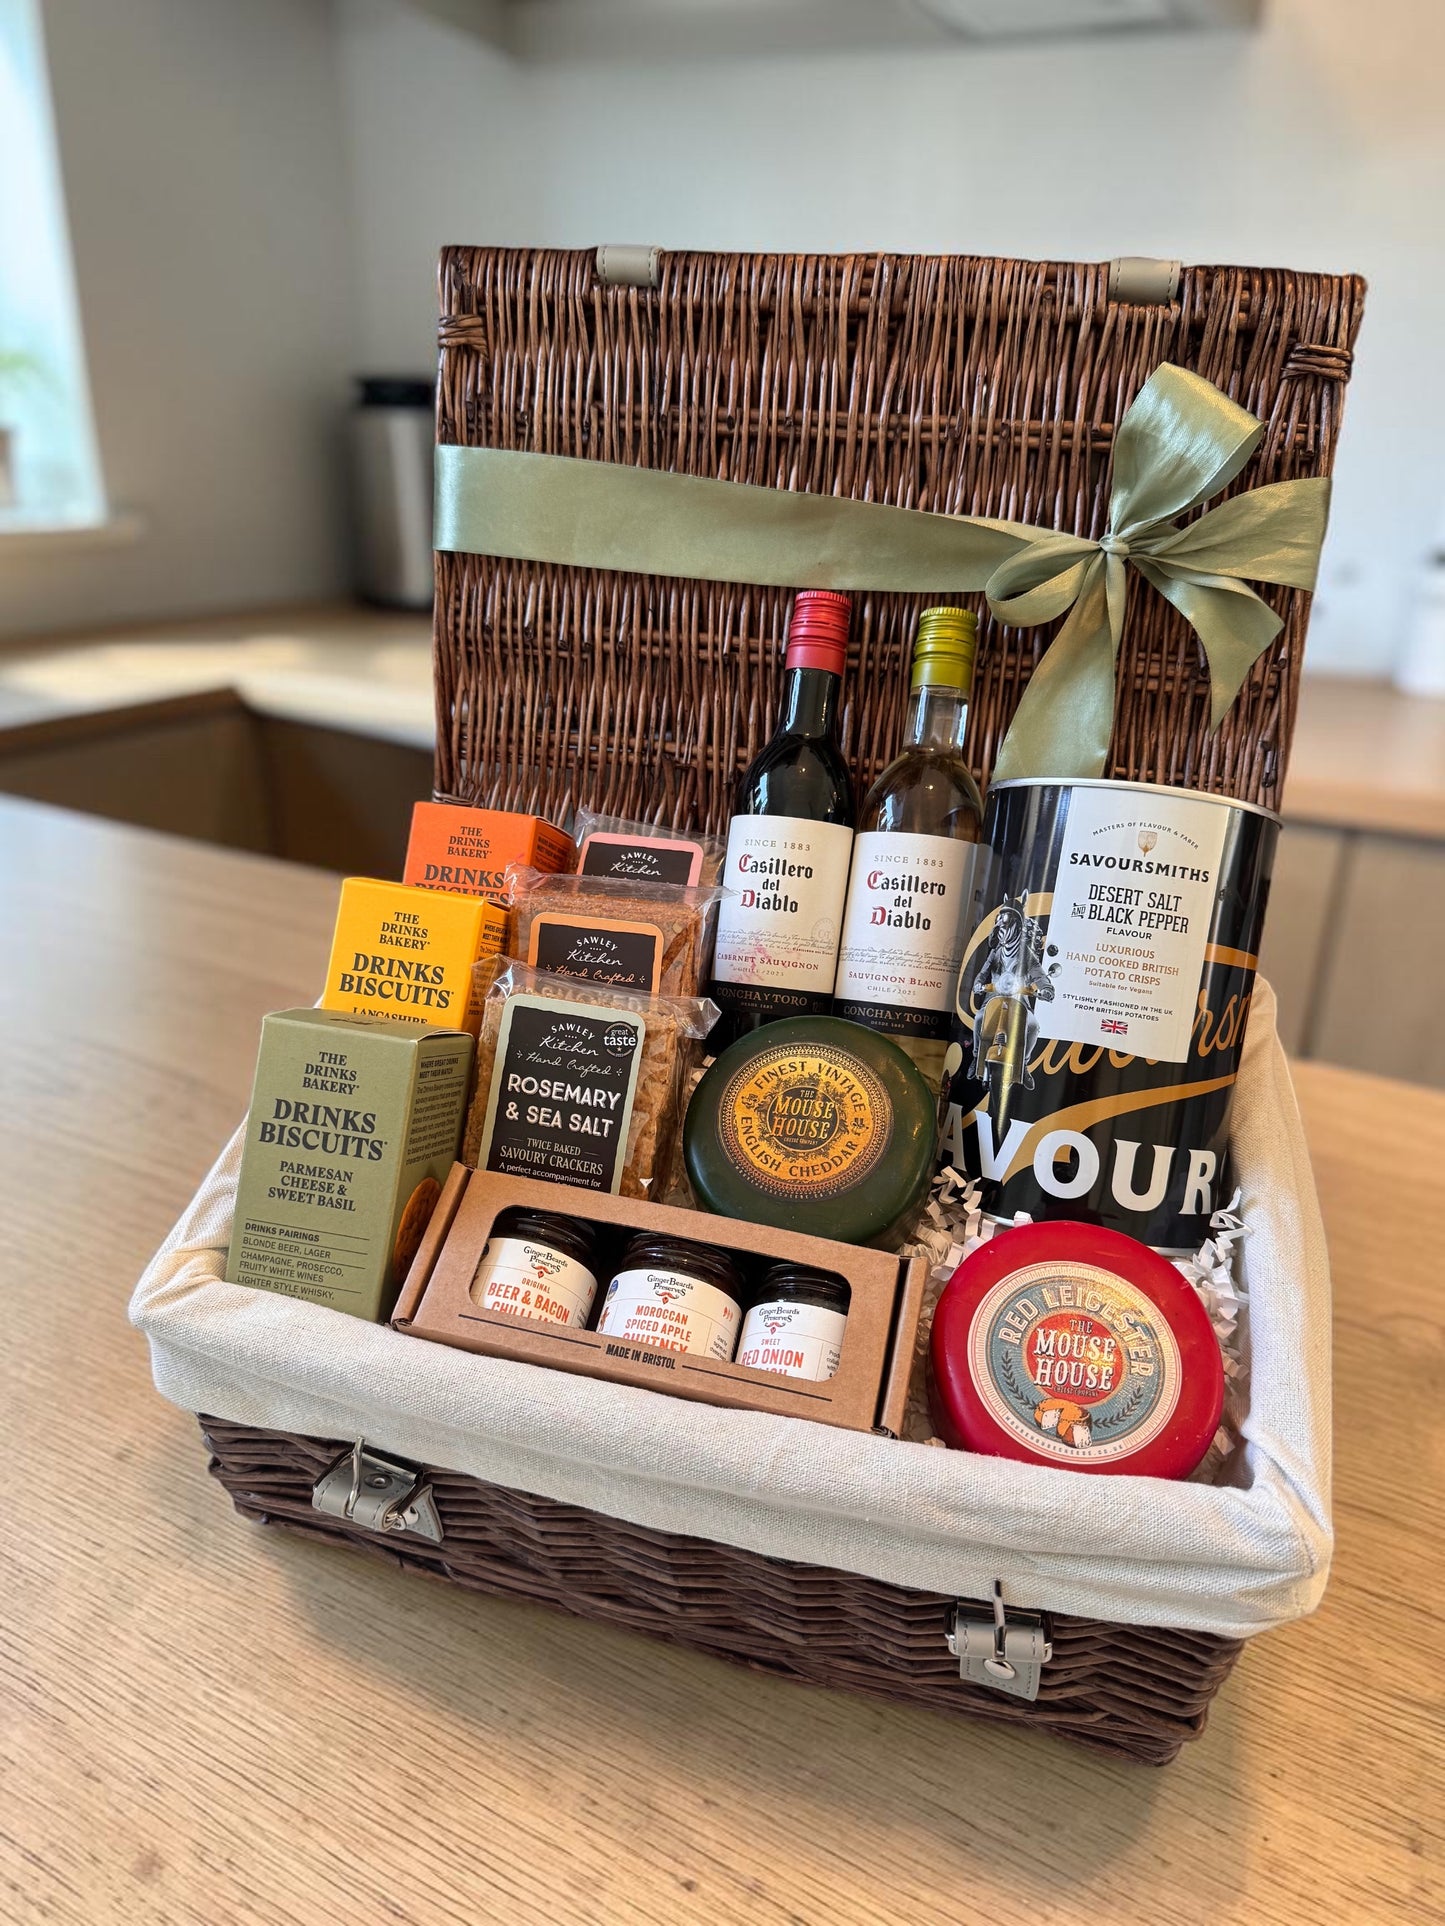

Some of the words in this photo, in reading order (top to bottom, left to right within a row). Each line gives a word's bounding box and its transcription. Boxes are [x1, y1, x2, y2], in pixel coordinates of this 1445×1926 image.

[460, 826, 482, 836] THE
[1092, 822, 1125, 836] MASTERS
[1139, 822, 1172, 833] FLAVOUR
[1180, 834, 1199, 849] FABER
[448, 846, 490, 858] BAKERY
[450, 836, 490, 848] DRINKS
[744, 839, 776, 848] SINCE
[783, 842, 811, 852] 1883
[610, 861, 661, 876] Kitchen
[621, 852, 659, 864] SAWLEY
[738, 854, 813, 879] Casillero
[874, 855, 909, 863] SINCE
[916, 858, 944, 868] 1883
[1070, 853, 1210, 883] SAVOURSMITHS
[424, 864, 505, 888] DRINKS
[762, 879, 780, 891] del
[867, 870, 945, 896] Casillero
[740, 889, 798, 913] Diablo
[894, 896, 912, 908] del
[1088, 884, 1143, 906] DESERT
[1147, 892, 1182, 912] SALT
[394, 912, 419, 925] THE
[870, 906, 931, 930] Diablo
[1072, 904, 1086, 918] AND
[1088, 904, 1134, 925] BLACK
[1138, 911, 1189, 934] PEPPER
[381, 922, 428, 938] DRINKS
[1107, 927, 1152, 940] FLAVOUR
[379, 934, 428, 950] BAKERY
[576, 936, 618, 951] SAWLEY
[1096, 943, 1155, 959] LUXURIOUS
[352, 952, 444, 984] DRINKS
[567, 949, 623, 966] Kitchen
[717, 953, 756, 963] CABERNET
[760, 957, 819, 970] SAUVIGNON
[1066, 952, 1096, 963] HAND
[1099, 957, 1139, 970] COOKED
[1142, 964, 1179, 976] BRITISH
[556, 964, 588, 978] Hand
[593, 970, 635, 984] Crafted
[848, 971, 906, 984] SAUVIGNON
[910, 978, 942, 988] BLANC
[1084, 967, 1126, 981] POTATO
[1128, 973, 1161, 986] CRISPS
[339, 973, 452, 1008] BISCUITS
[717, 987, 760, 1000] CONCHA
[773, 994, 807, 1006] TORO
[1089, 980, 1116, 990] Suitable
[1129, 986, 1153, 996] Vegans
[1063, 994, 1098, 1004] STYLISHLY
[1100, 999, 1139, 1010] FASHIONED
[1150, 1006, 1162, 1014] THE
[1074, 1004, 1094, 1012] FROM
[1096, 1007, 1123, 1017] BRITISH
[1125, 1012, 1159, 1022] POTATOES
[843, 1005, 892, 1019] CONCHA
[895, 1012, 902, 1020] Y
[903, 1013, 938, 1026] TORO
[551, 1022, 595, 1039] SAWLEY
[604, 1036, 636, 1046] taste
[611, 1029, 628, 1037] great
[539, 1036, 599, 1056] Kitchen
[319, 1052, 347, 1066] THE
[526, 1052, 562, 1066] Hand
[567, 1060, 612, 1078] Crafted
[305, 1064, 357, 1081] DRINKS
[302, 1077, 357, 1095] BAKERY
[507, 1073, 621, 1111] ROSEMARY
[754, 1061, 807, 1090] FINEST
[817, 1063, 866, 1112] VINTAGE
[801, 1090, 815, 1098] THE
[273, 1098, 376, 1134] DRINKS
[772, 1096, 836, 1119] MOUSE
[505, 1101, 519, 1120] &
[526, 1105, 562, 1129] SEA
[568, 1114, 614, 1138] SALT
[768, 1116, 831, 1140] HOUSE
[259, 1121, 384, 1161] BISCUITS
[527, 1137, 552, 1150] TWICE
[554, 1142, 581, 1156] BAKED
[741, 1116, 782, 1172] ENGLISH
[789, 1140, 858, 1178] CHEDDAR
[500, 1146, 548, 1165] SAVOURY
[550, 1154, 603, 1176] CRACKERS
[280, 1161, 353, 1183] PARMESAN
[507, 1164, 531, 1176] perfect
[532, 1169, 590, 1185] accompaniment
[591, 1179, 601, 1188] for
[281, 1175, 335, 1194] CHEESE
[337, 1184, 347, 1196] &
[268, 1187, 315, 1204] SWEET
[317, 1195, 356, 1211] BASIL
[245, 1222, 277, 1235] DRINKS
[279, 1228, 320, 1242] PAIRINGS
[243, 1237, 276, 1249] BLONDE
[278, 1244, 301, 1254] BEER,
[304, 1248, 331, 1258] LAGER
[240, 1261, 268, 1272] FRUITY
[269, 1267, 294, 1278] WHITE
[297, 1272, 324, 1282] WINES
[241, 1251, 295, 1267] CHAMPAGNE,
[297, 1261, 344, 1277] PROSECCO,
[238, 1276, 271, 1288] LIGHTER
[273, 1282, 298, 1293] STYLE
[301, 1288, 334, 1300] WHISKY,
[522, 1278, 550, 1294] ORIGINAL
[488, 1282, 520, 1301] BEER
[521, 1290, 531, 1305] &
[534, 1294, 570, 1324] BACON
[635, 1305, 688, 1326] MOROCCAN
[625, 1319, 658, 1332] SPICED
[660, 1323, 692, 1342] APPLE
[998, 1299, 1040, 1345] RED
[1042, 1285, 1154, 1377] LEICESTER
[1069, 1320, 1094, 1333] THE
[1033, 1328, 1116, 1364] MOUSE
[606, 1344, 631, 1359] MADE
[631, 1349, 640, 1361] IN
[642, 1352, 676, 1370] BRISTOL
[741, 1349, 759, 1365] RED
[762, 1348, 804, 1368] ONION
[1033, 1358, 1113, 1391] HOUSE
